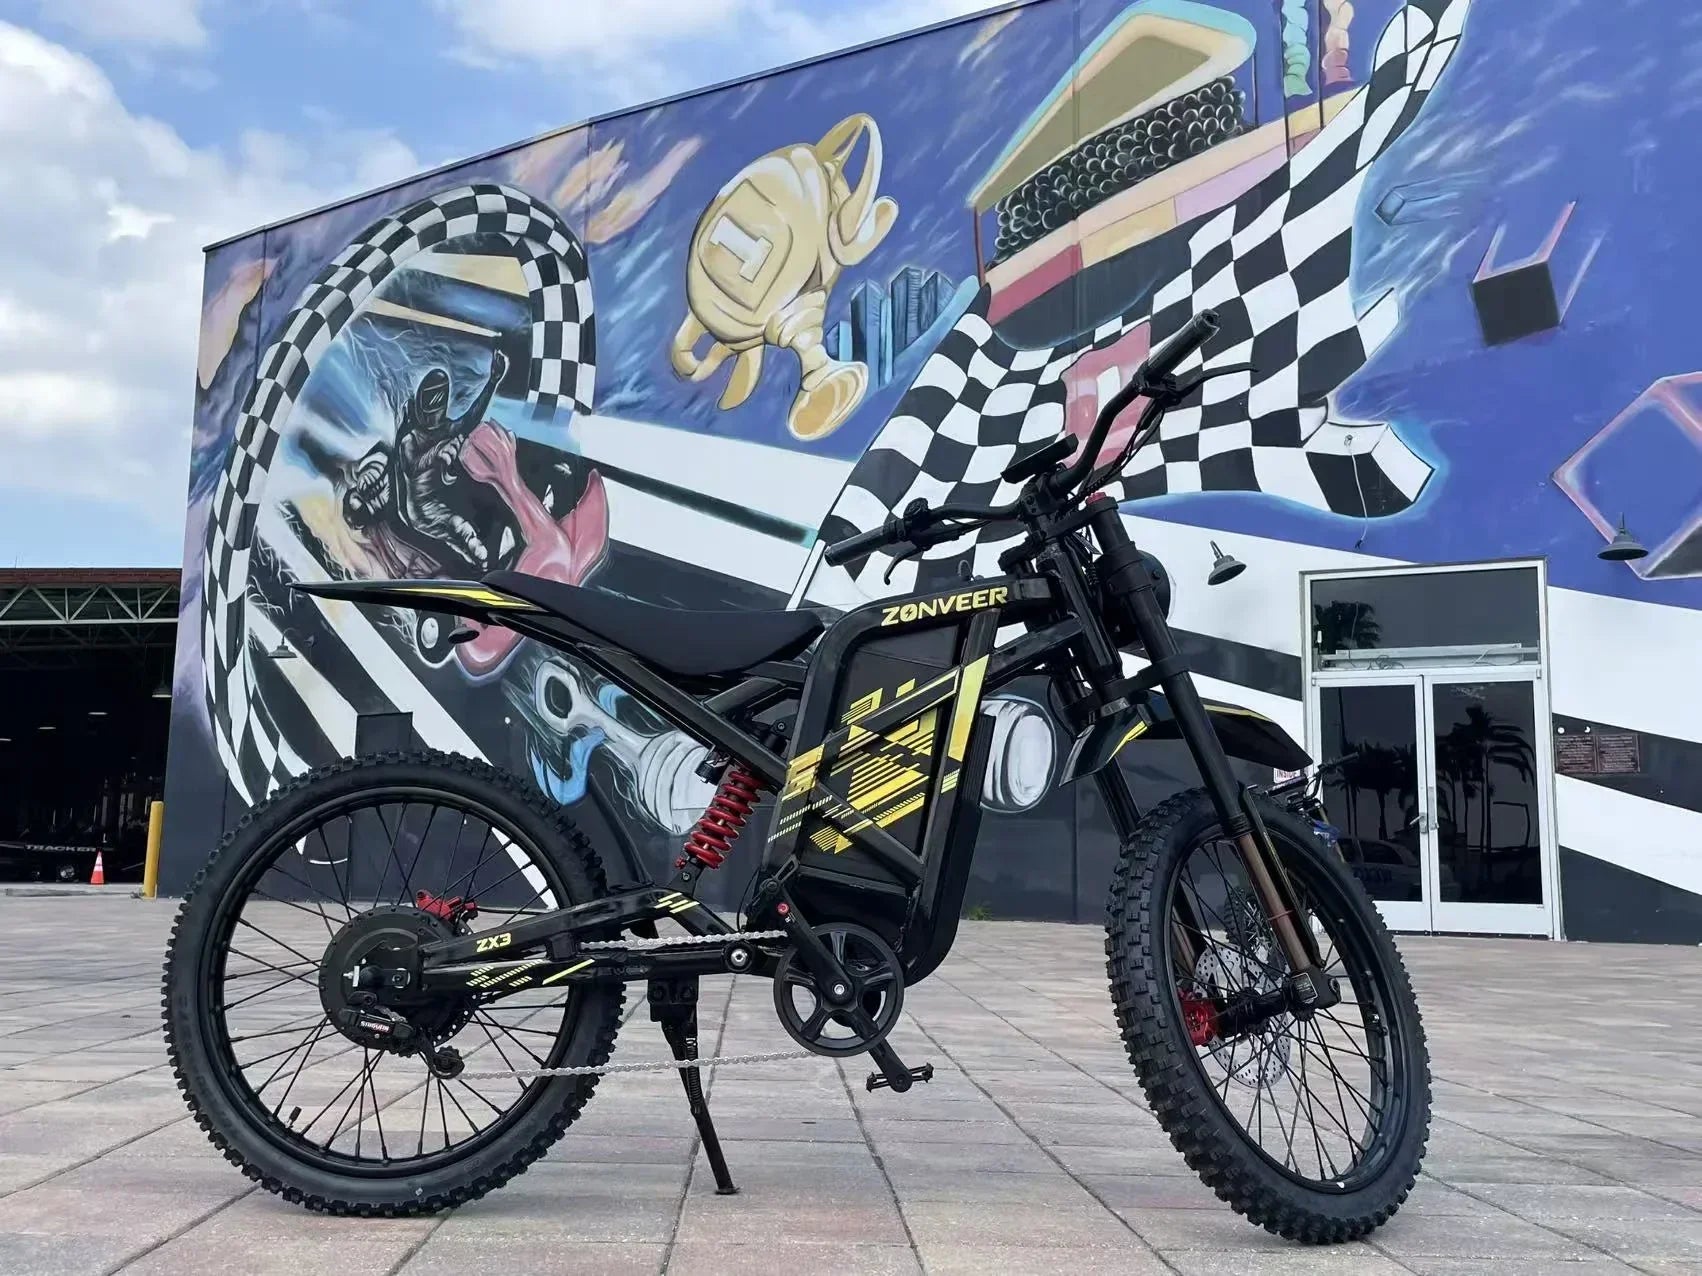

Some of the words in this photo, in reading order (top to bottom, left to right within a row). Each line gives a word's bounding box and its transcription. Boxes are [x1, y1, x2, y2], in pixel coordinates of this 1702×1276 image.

[881, 586, 1008, 627] ZONVEER
[25, 844, 97, 852] TRACKER
[476, 932, 512, 953] ZX3
